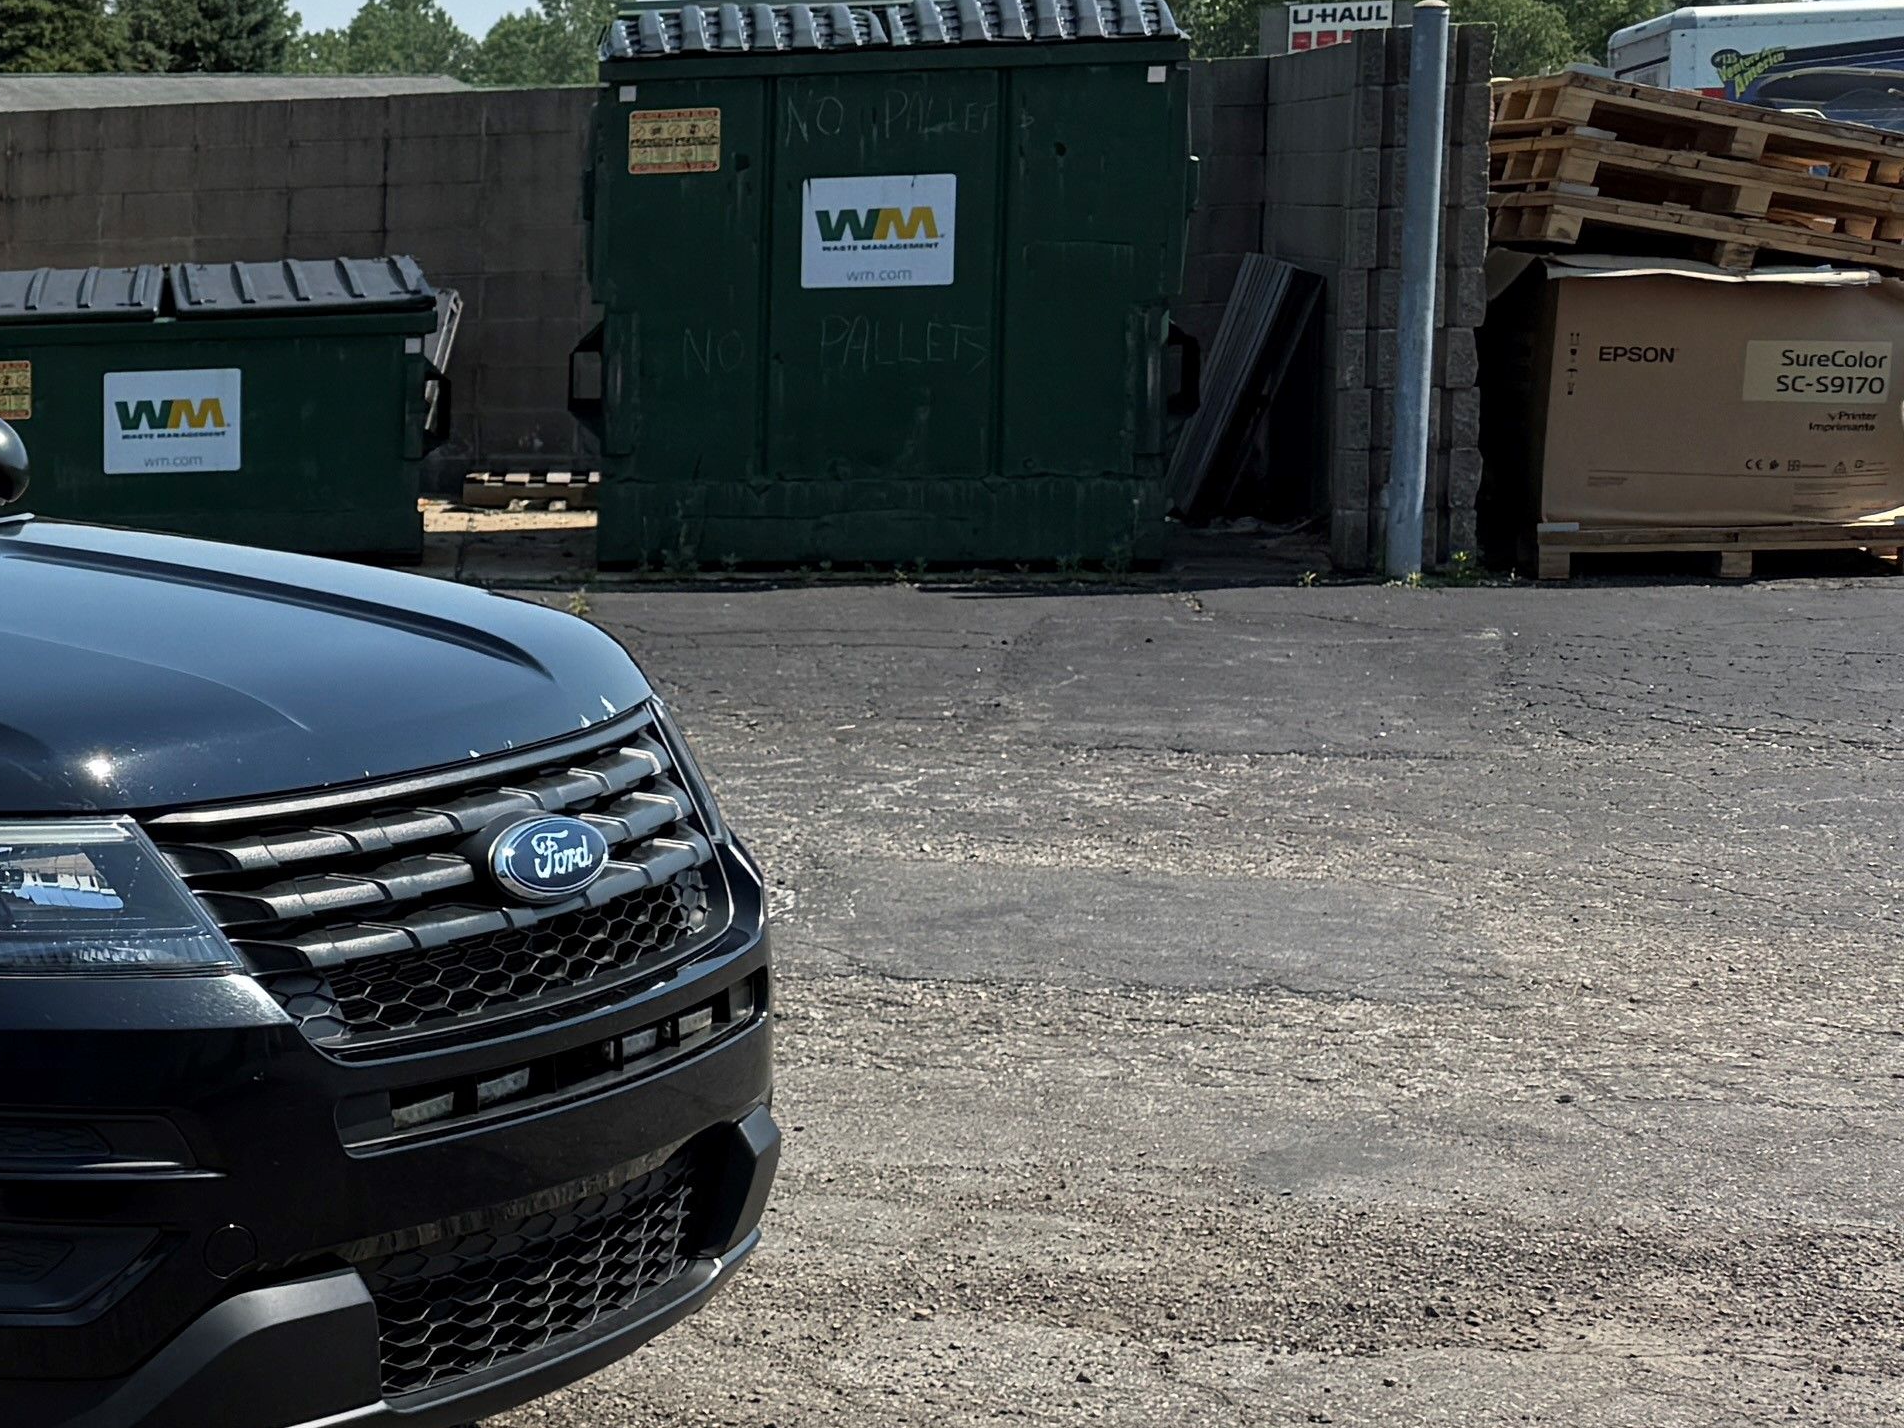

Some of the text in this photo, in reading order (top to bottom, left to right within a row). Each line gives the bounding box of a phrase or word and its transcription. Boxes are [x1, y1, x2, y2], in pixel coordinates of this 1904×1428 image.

[1293, 6, 1388, 24] U-HAUL
[785, 95, 844, 147] NO
[815, 207, 939, 241] WM
[822, 242, 940, 252] WASTE MANAGEMENT
[846, 269, 912, 282] wm.com
[683, 315, 990, 378] NO PALLETS
[1599, 346, 1675, 363] EPSON
[1781, 350, 1888, 369] SureColor
[1776, 375, 1885, 394] SC-S9170
[115, 398, 226, 430] WM
[144, 456, 203, 468] wm.com
[531, 830, 593, 879] Ford
